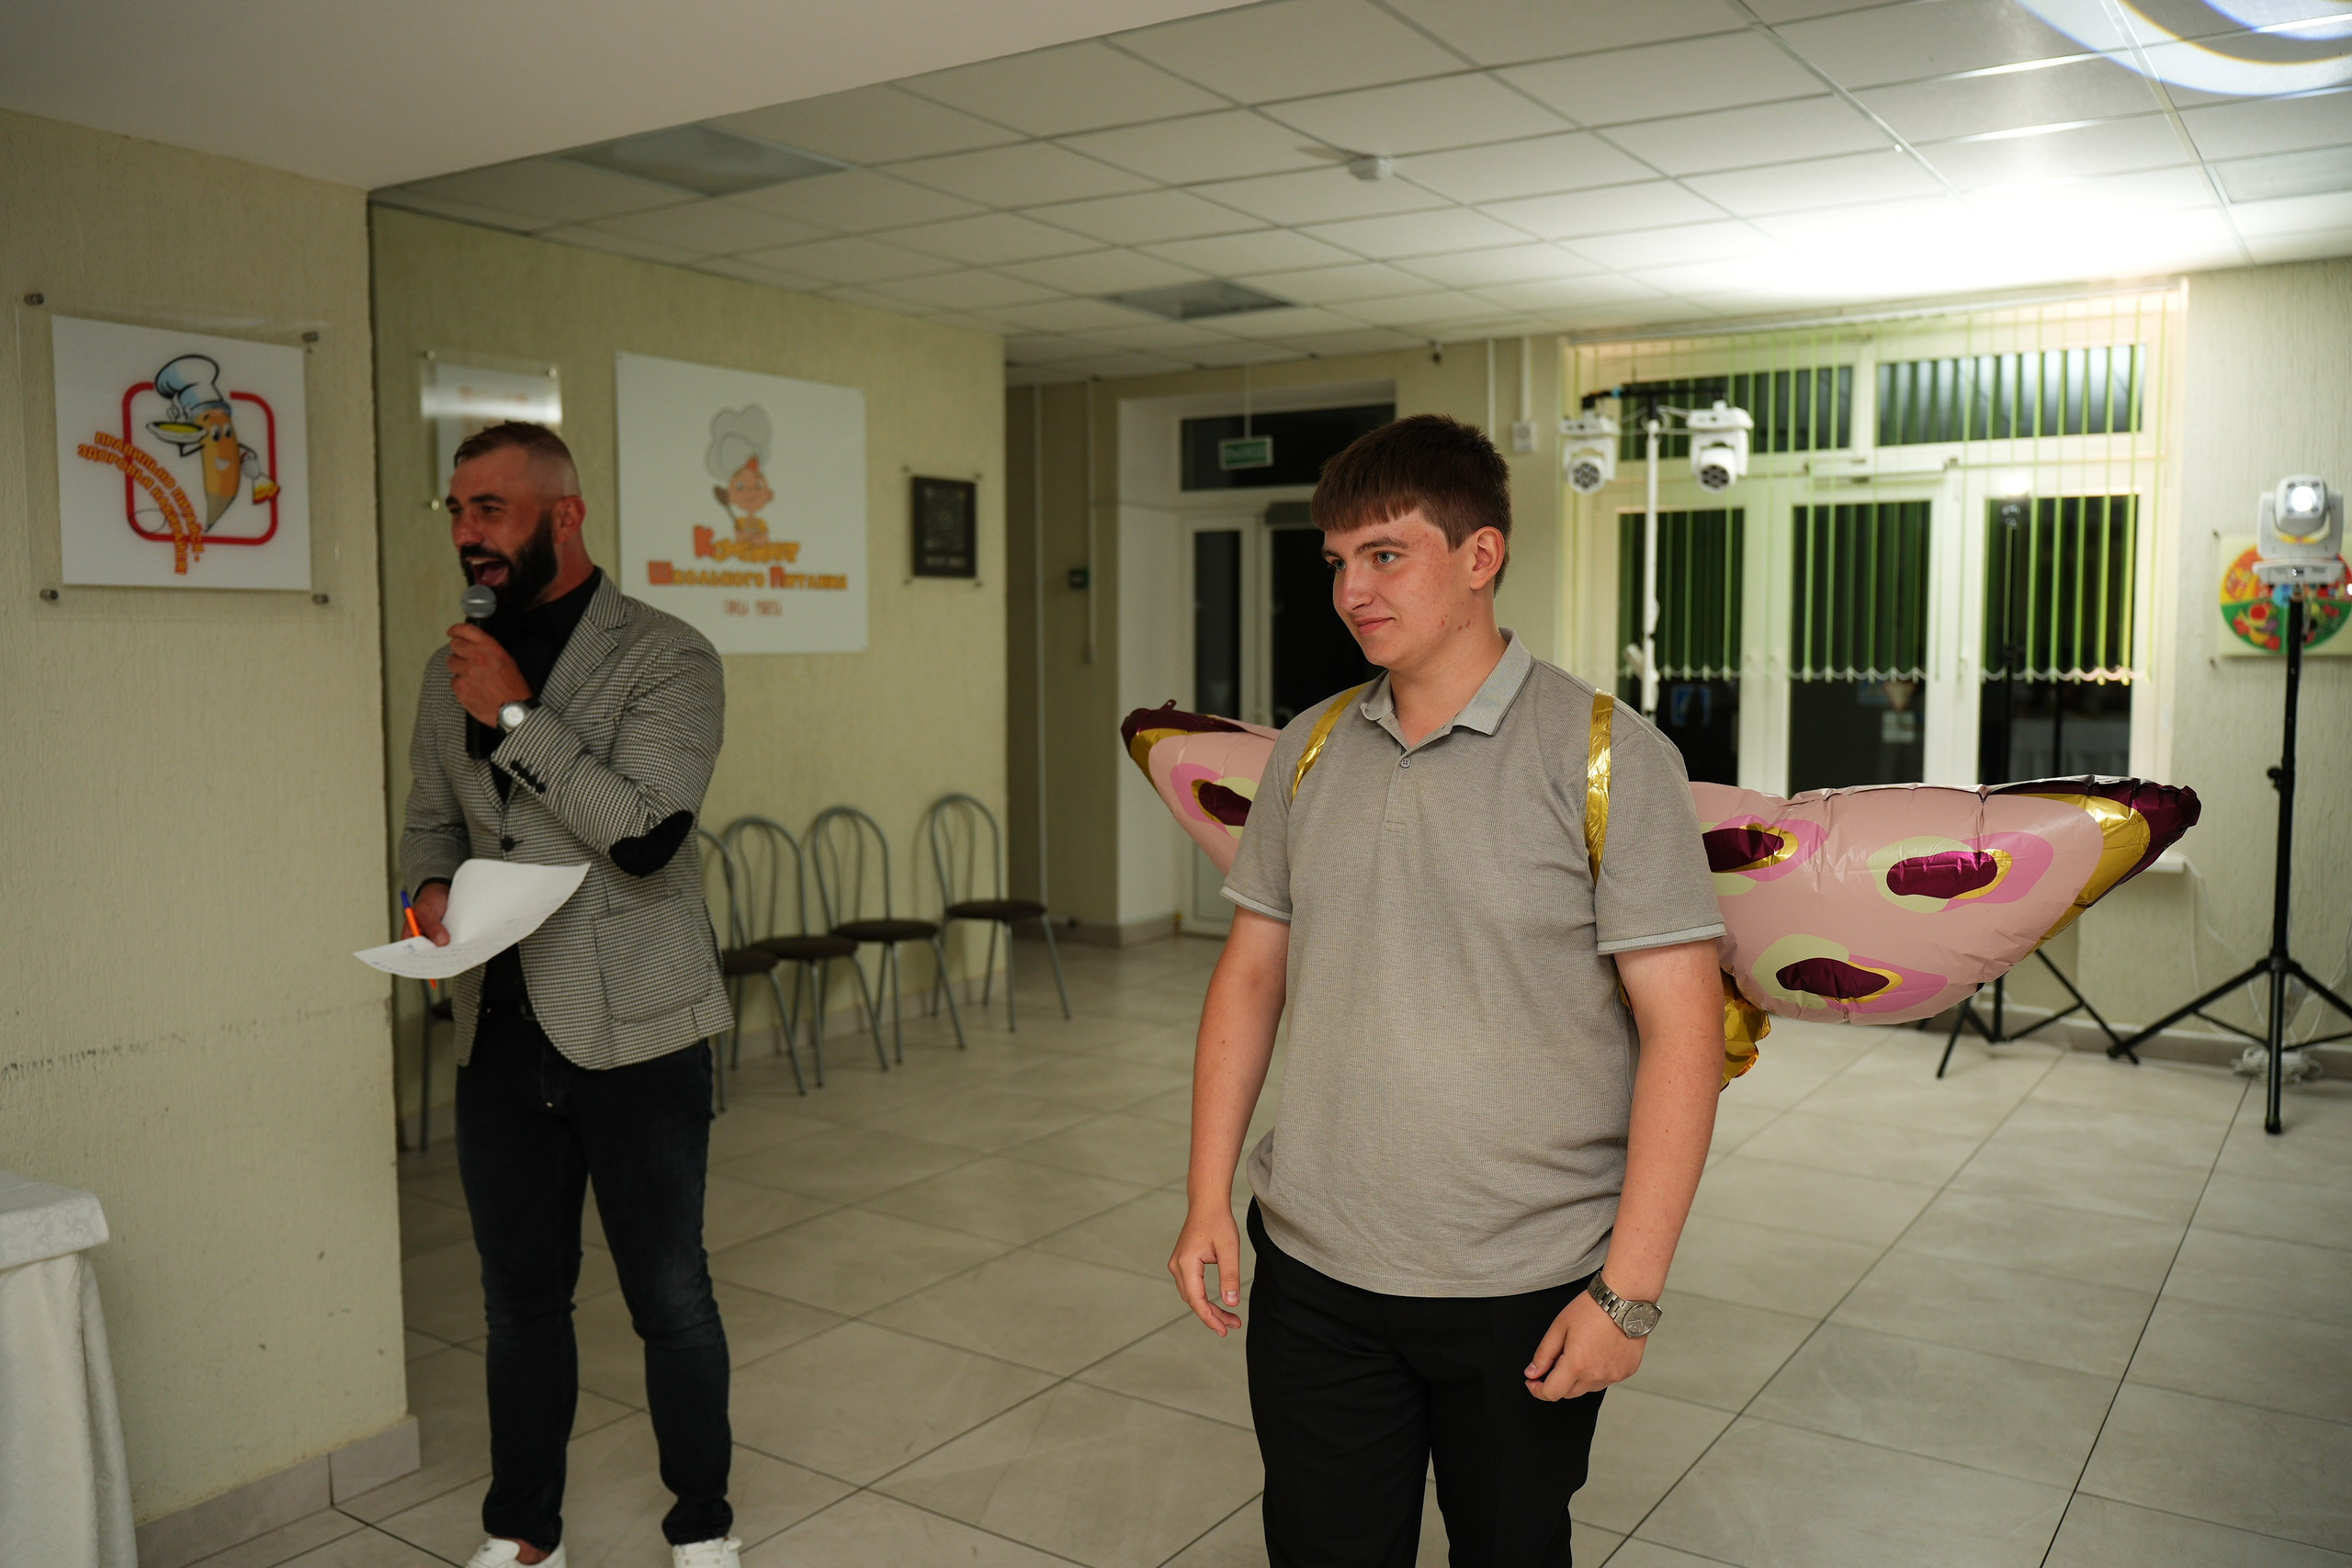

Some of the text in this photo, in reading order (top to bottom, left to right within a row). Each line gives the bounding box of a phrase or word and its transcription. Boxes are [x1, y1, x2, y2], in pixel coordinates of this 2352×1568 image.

[77, 443, 155, 491] ЗДОРОВЬЯ
[94, 431, 176, 489] ПРАВИЛЬНО
[171, 487, 204, 553] ПИТАЙСЯ
